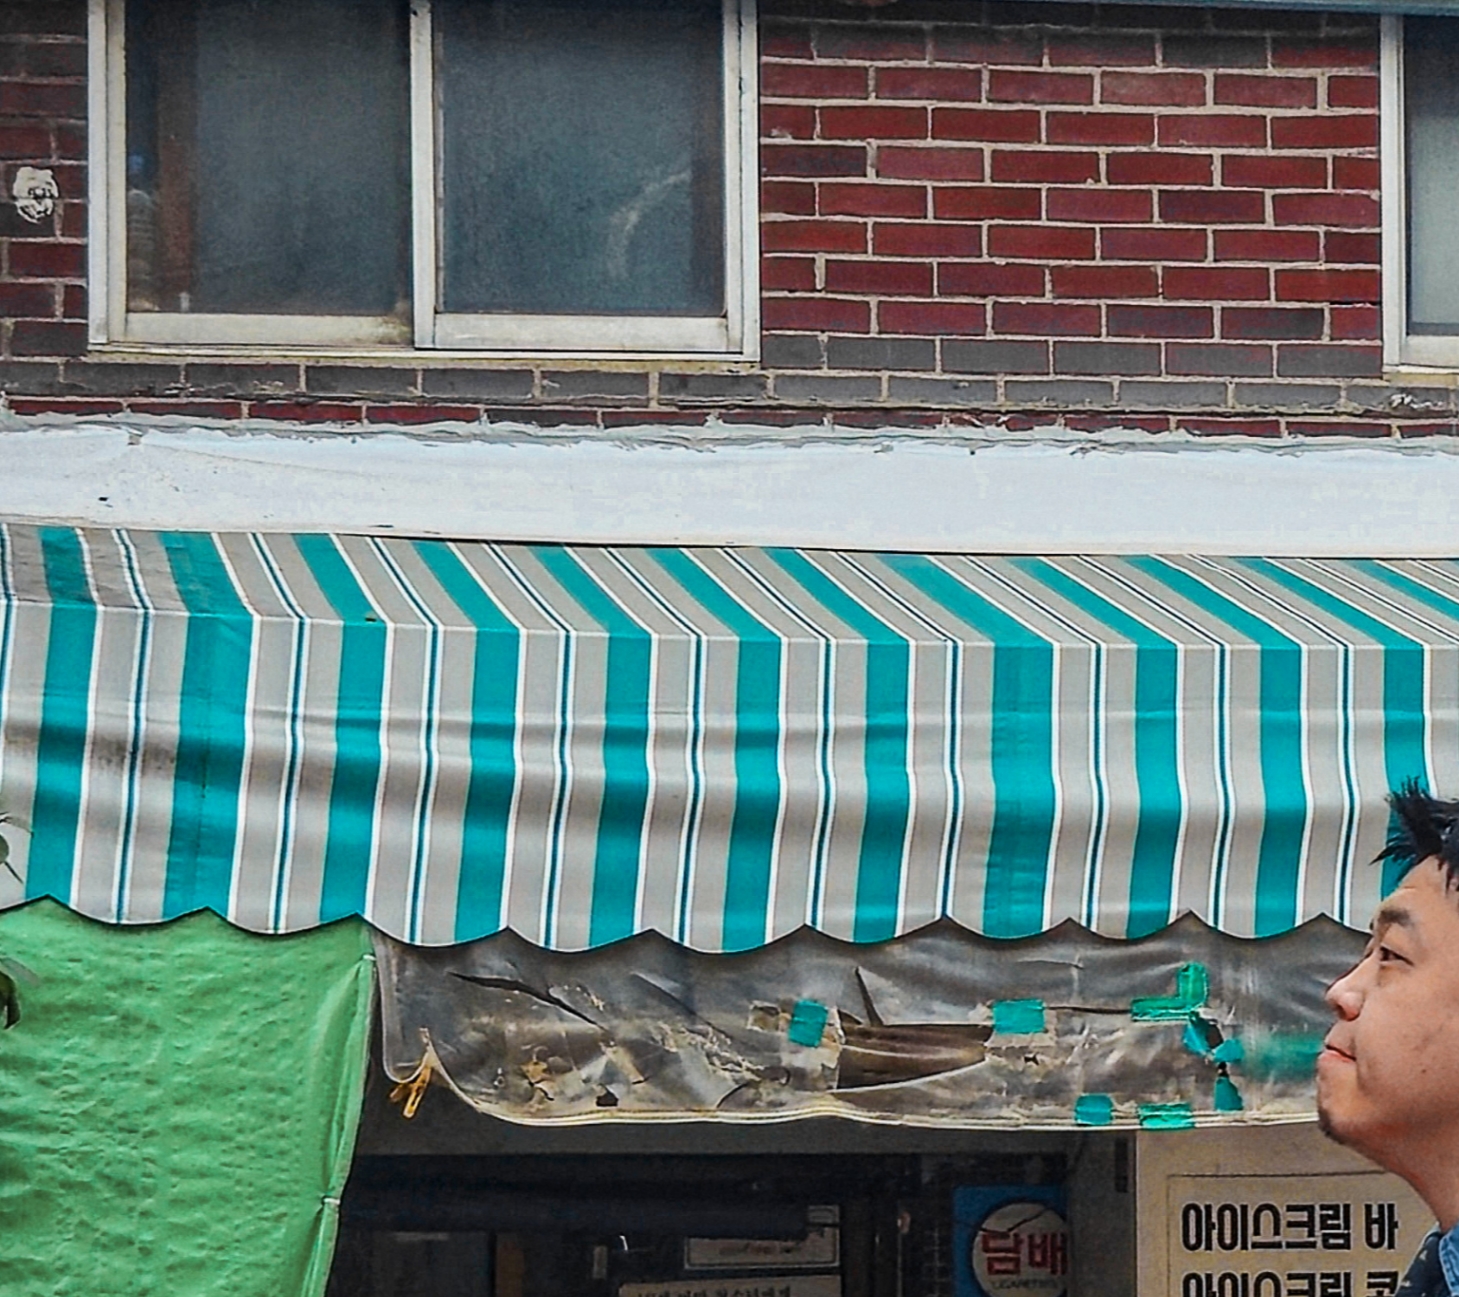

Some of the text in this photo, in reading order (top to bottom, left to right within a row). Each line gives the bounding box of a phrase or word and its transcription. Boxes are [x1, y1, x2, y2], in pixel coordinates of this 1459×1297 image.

[1181, 1202, 1398, 1251] 아이스크림 바
[982, 1232, 1067, 1276] 담배
